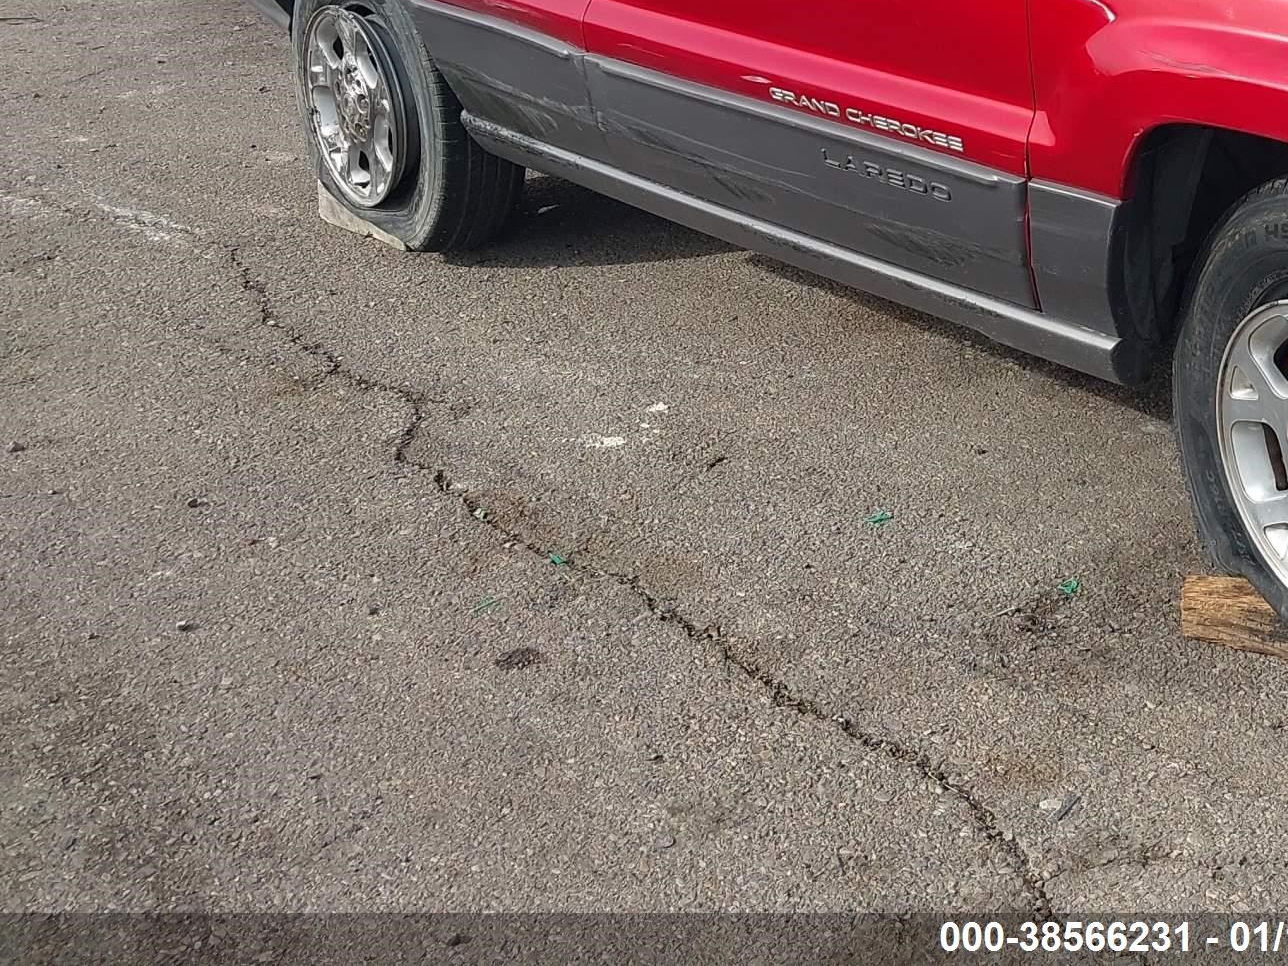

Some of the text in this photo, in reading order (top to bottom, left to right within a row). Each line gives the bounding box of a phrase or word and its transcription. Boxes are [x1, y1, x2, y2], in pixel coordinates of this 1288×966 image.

[768, 87, 964, 152] GRAND CHEROKEE
[820, 148, 952, 201] LAREDO
